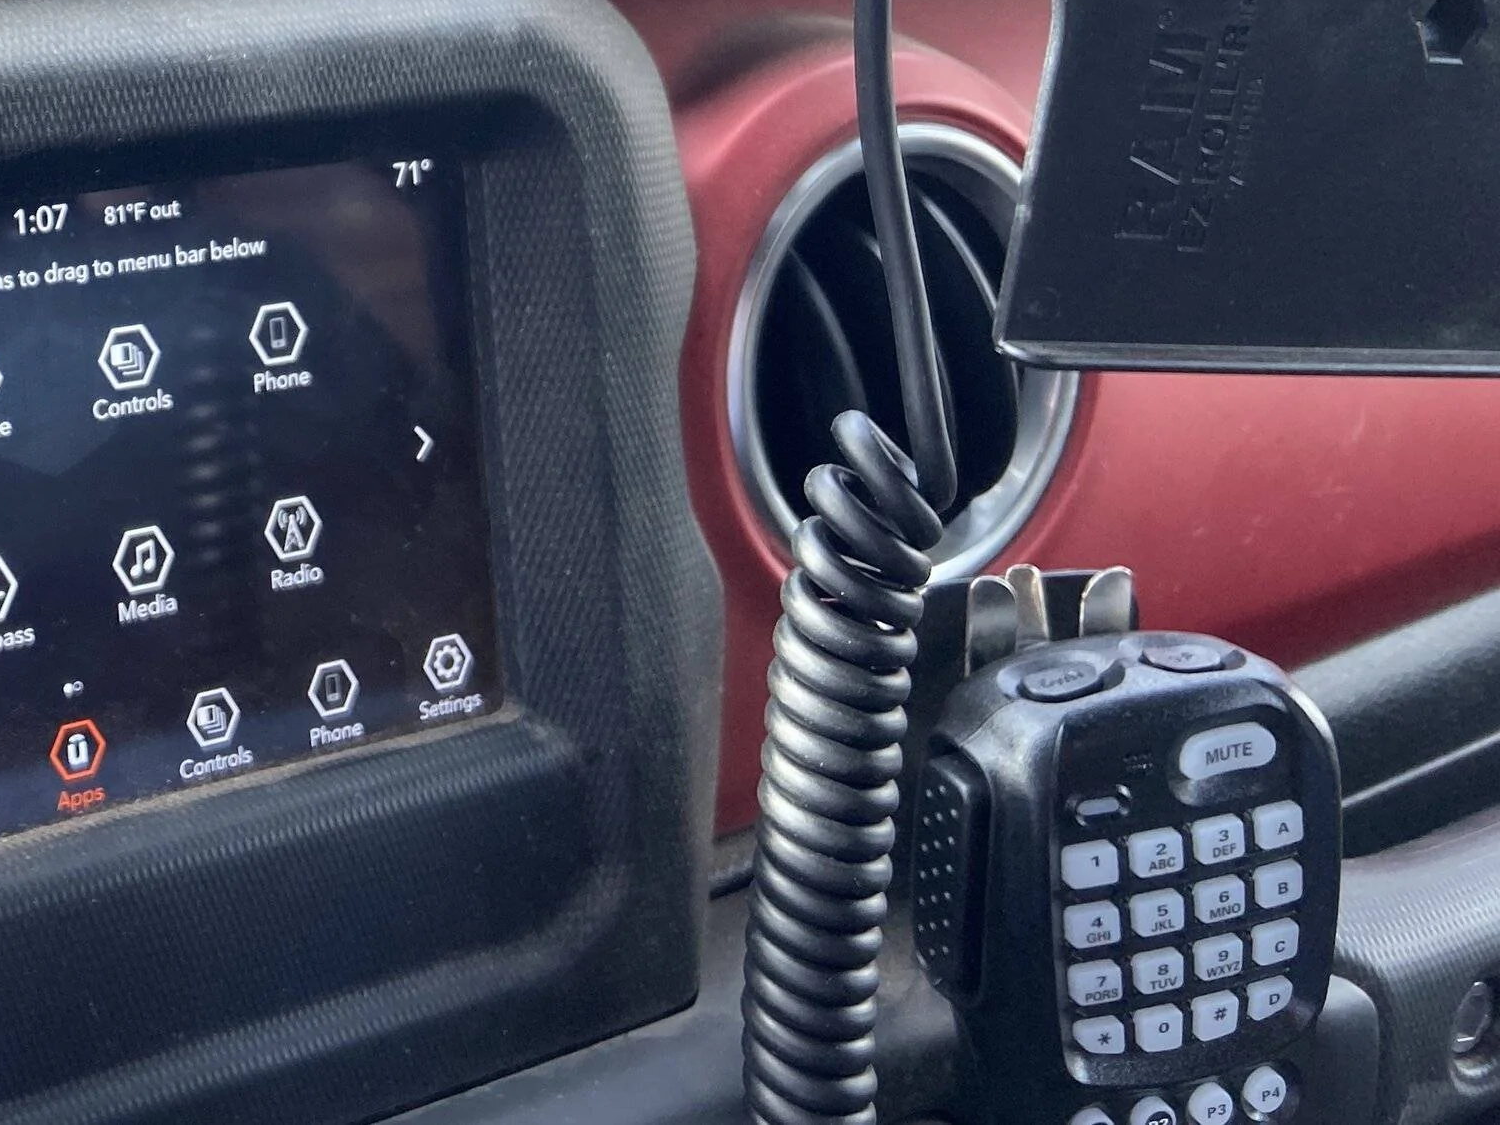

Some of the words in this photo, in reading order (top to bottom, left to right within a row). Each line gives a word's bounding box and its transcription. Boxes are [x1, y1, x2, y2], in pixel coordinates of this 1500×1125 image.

[393, 159, 431, 187] 71°
[14, 203, 68, 235] 1:07
[105, 202, 146, 225] 81°F
[150, 201, 180, 219] out
[18, 270, 40, 287] to
[44, 262, 89, 284] drag
[92, 260, 114, 277] to
[118, 254, 172, 273] menu
[175, 245, 207, 265] bar
[210, 237, 266, 261] below
[254, 371, 311, 393] Phone
[93, 387, 173, 420] Controls
[271, 563, 323, 590] Radio
[118, 593, 177, 623] Media
[419, 690, 482, 720] Settings
[310, 723, 367, 749] Phone
[180, 747, 254, 780] Controls
[1206, 742, 1254, 768] MUTE
[56, 785, 107, 813] Apps
[1219, 830, 1229, 842] 3
[1278, 822, 1289, 835] A
[1156, 843, 1167, 856] 2
[1213, 843, 1239, 859] DEF
[1091, 856, 1099, 867] 1
[1149, 854, 1178, 873] ABC
[1278, 882, 1288, 894] B
[1219, 891, 1230, 906] 6
[1157, 905, 1170, 920] 5
[1210, 902, 1244, 921] MNO
[1091, 917, 1103, 928] 4
[1152, 919, 1177, 935] JKL
[1086, 931, 1113, 945] GHI
[1275, 941, 1285, 953] C
[1218, 950, 1231, 965] 9
[1158, 964, 1169, 975] 8
[1207, 961, 1242, 978] WXYZ
[1096, 976, 1106, 987] 7
[1150, 977, 1180, 992] TUV
[1269, 994, 1280, 1005] D
[1262, 1087, 1282, 1104] P4
[1208, 1104, 1229, 1121] P3
